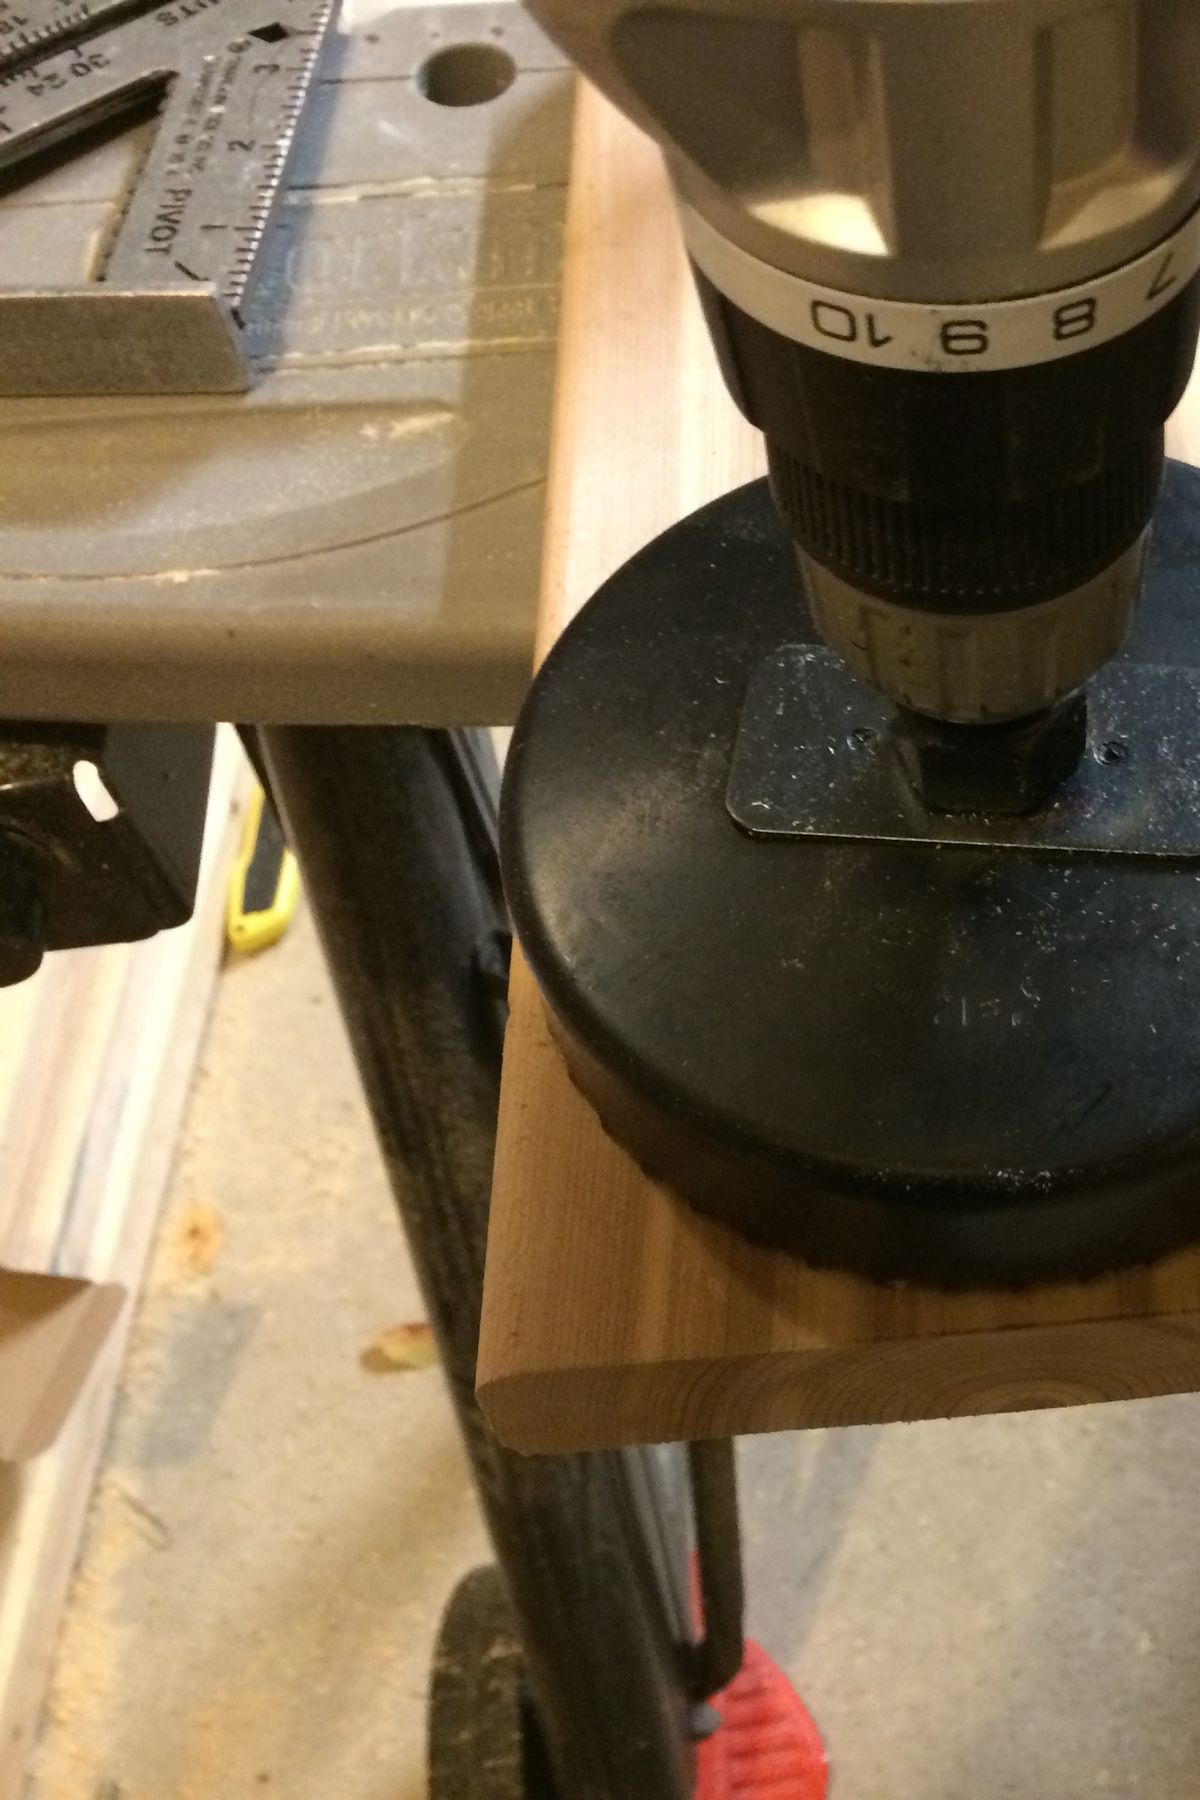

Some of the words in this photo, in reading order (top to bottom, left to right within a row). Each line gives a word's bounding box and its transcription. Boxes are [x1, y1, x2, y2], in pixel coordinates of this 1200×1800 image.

[144, 188, 192, 255] PIVOT
[1144, 251, 1177, 301] 7
[811, 299, 893, 348] 10
[940, 319, 990, 356] 9
[1053, 297, 1097, 340] 8
